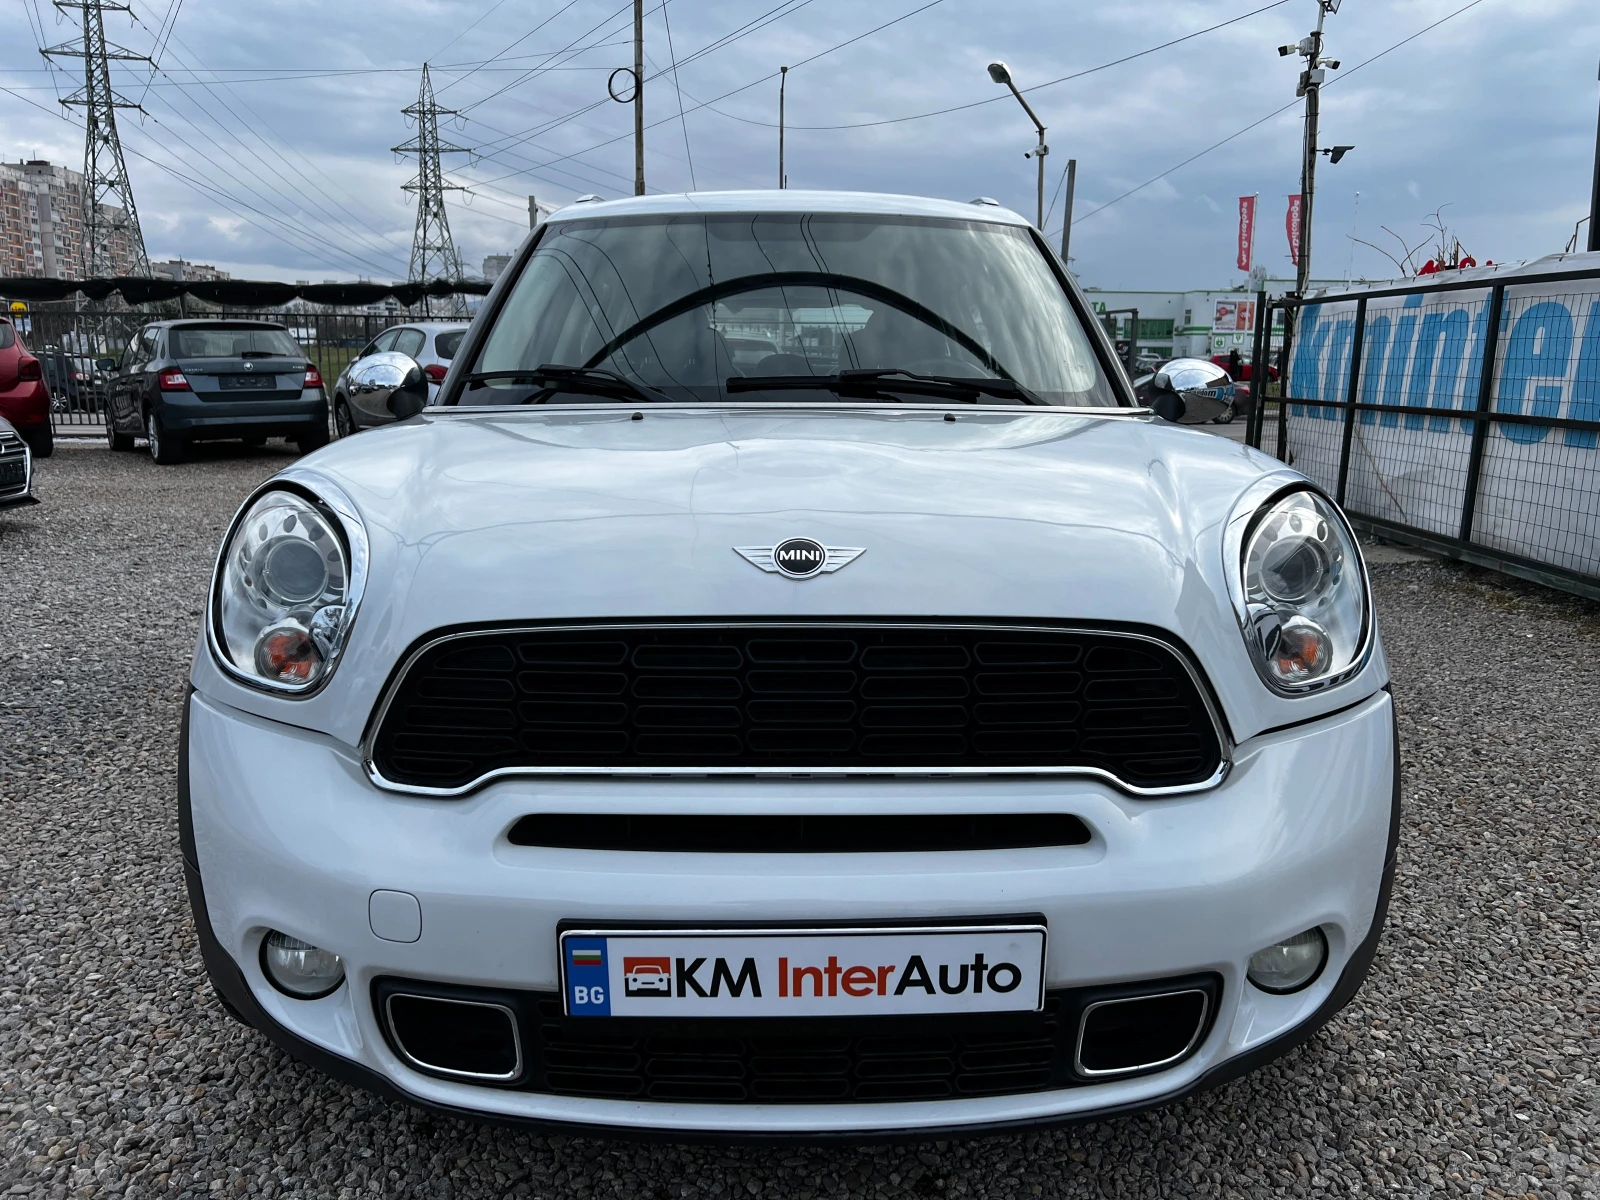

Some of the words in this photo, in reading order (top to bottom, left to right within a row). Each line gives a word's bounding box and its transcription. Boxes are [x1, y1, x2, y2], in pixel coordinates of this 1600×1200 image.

[779, 549, 821, 561] MINI
[675, 957, 763, 998] KM
[574, 985, 605, 1005] BG
